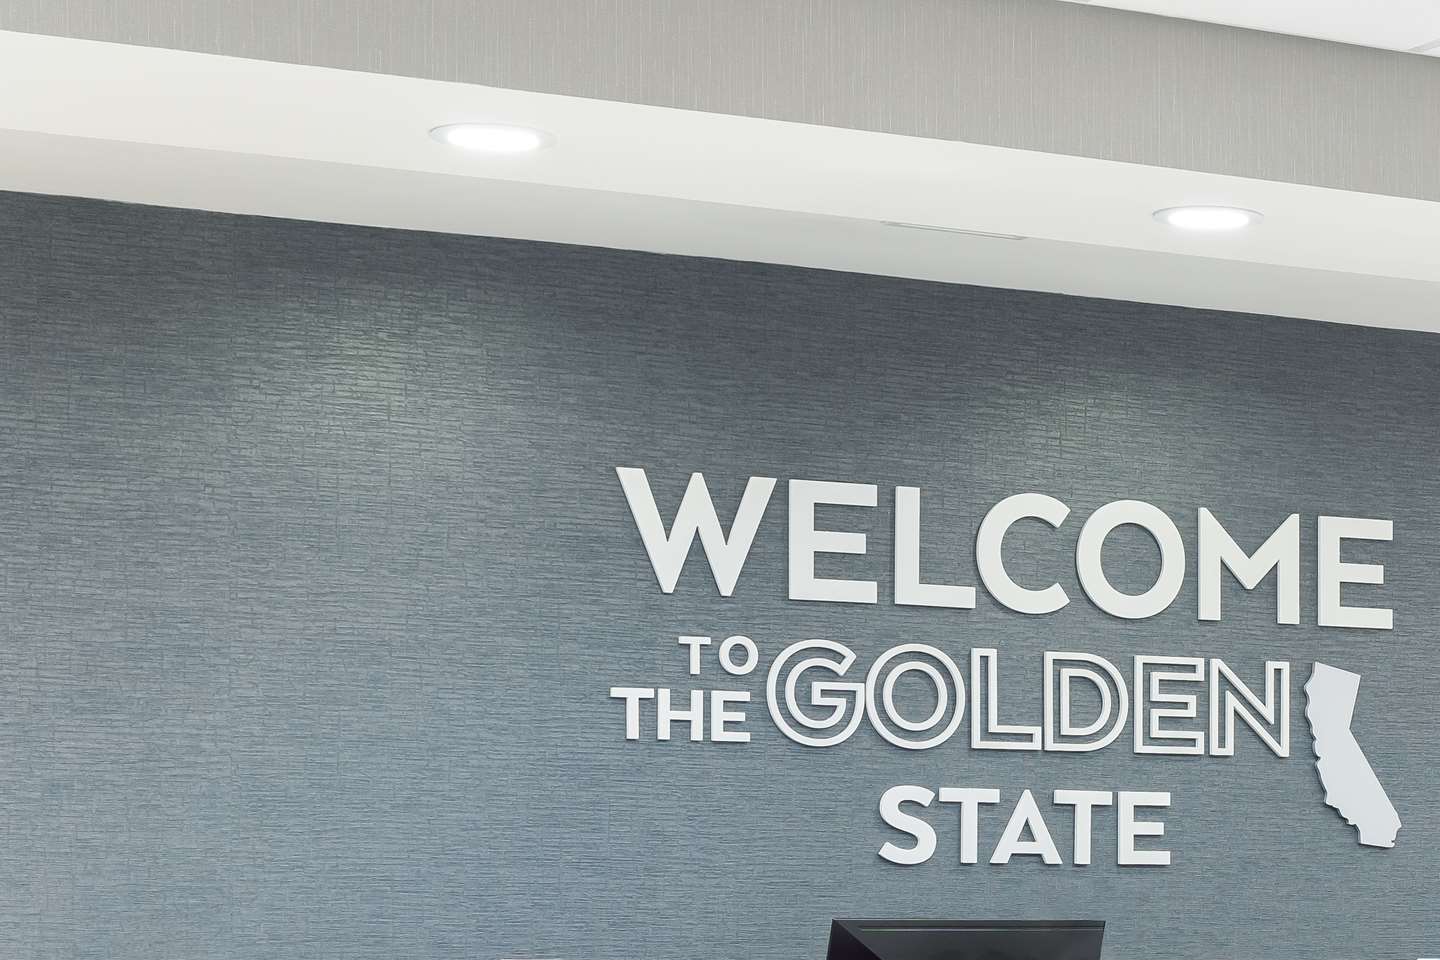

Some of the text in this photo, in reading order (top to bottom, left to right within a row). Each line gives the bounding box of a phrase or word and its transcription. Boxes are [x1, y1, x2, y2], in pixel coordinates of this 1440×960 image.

[615, 466, 1394, 631] WELCOME
[609, 638, 1291, 759] THE GOLDEN
[678, 636, 760, 676] TO
[877, 785, 1173, 867] STATE
